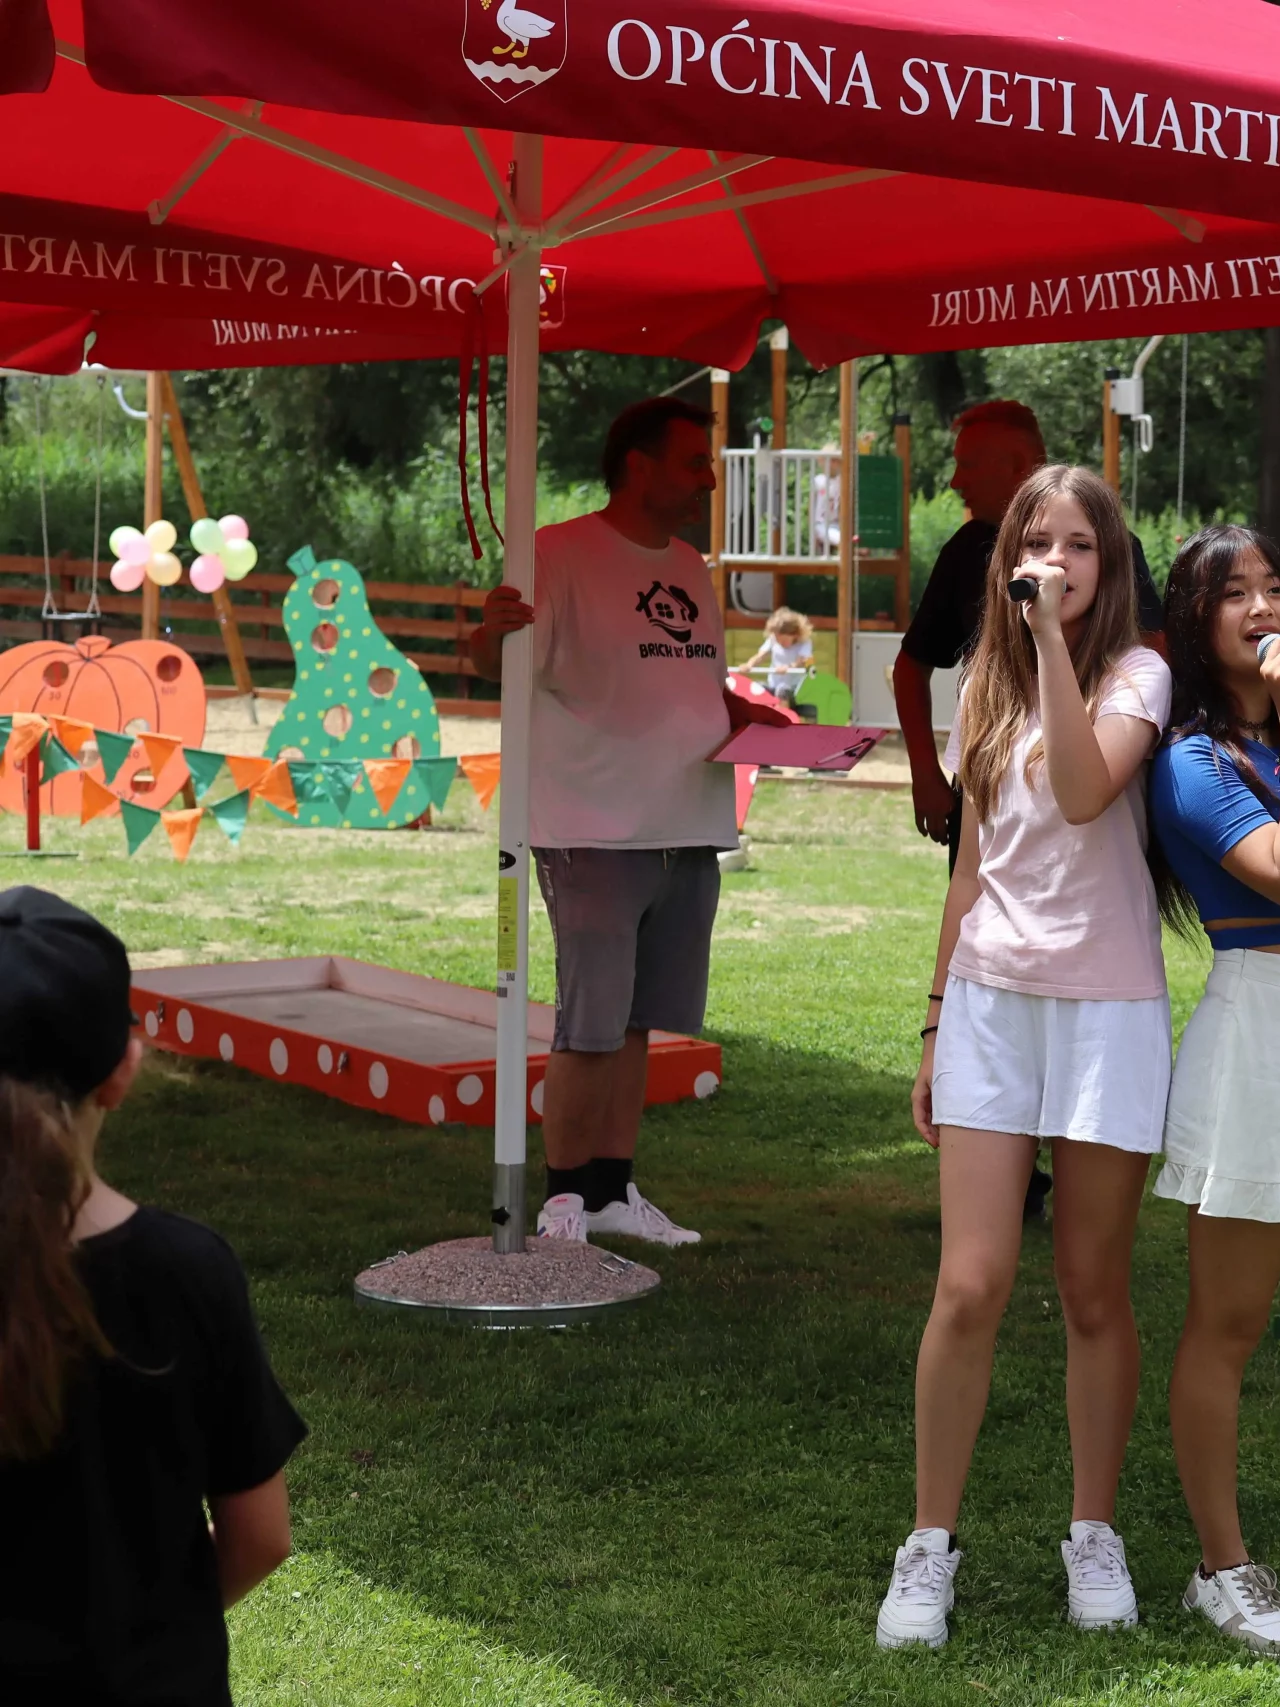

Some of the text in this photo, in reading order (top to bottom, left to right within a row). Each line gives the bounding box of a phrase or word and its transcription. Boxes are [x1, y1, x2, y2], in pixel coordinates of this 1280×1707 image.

[606, 18, 882, 110] OPĆINA
[899, 57, 1077, 137] SVETI
[673, 645, 684, 659] BY
